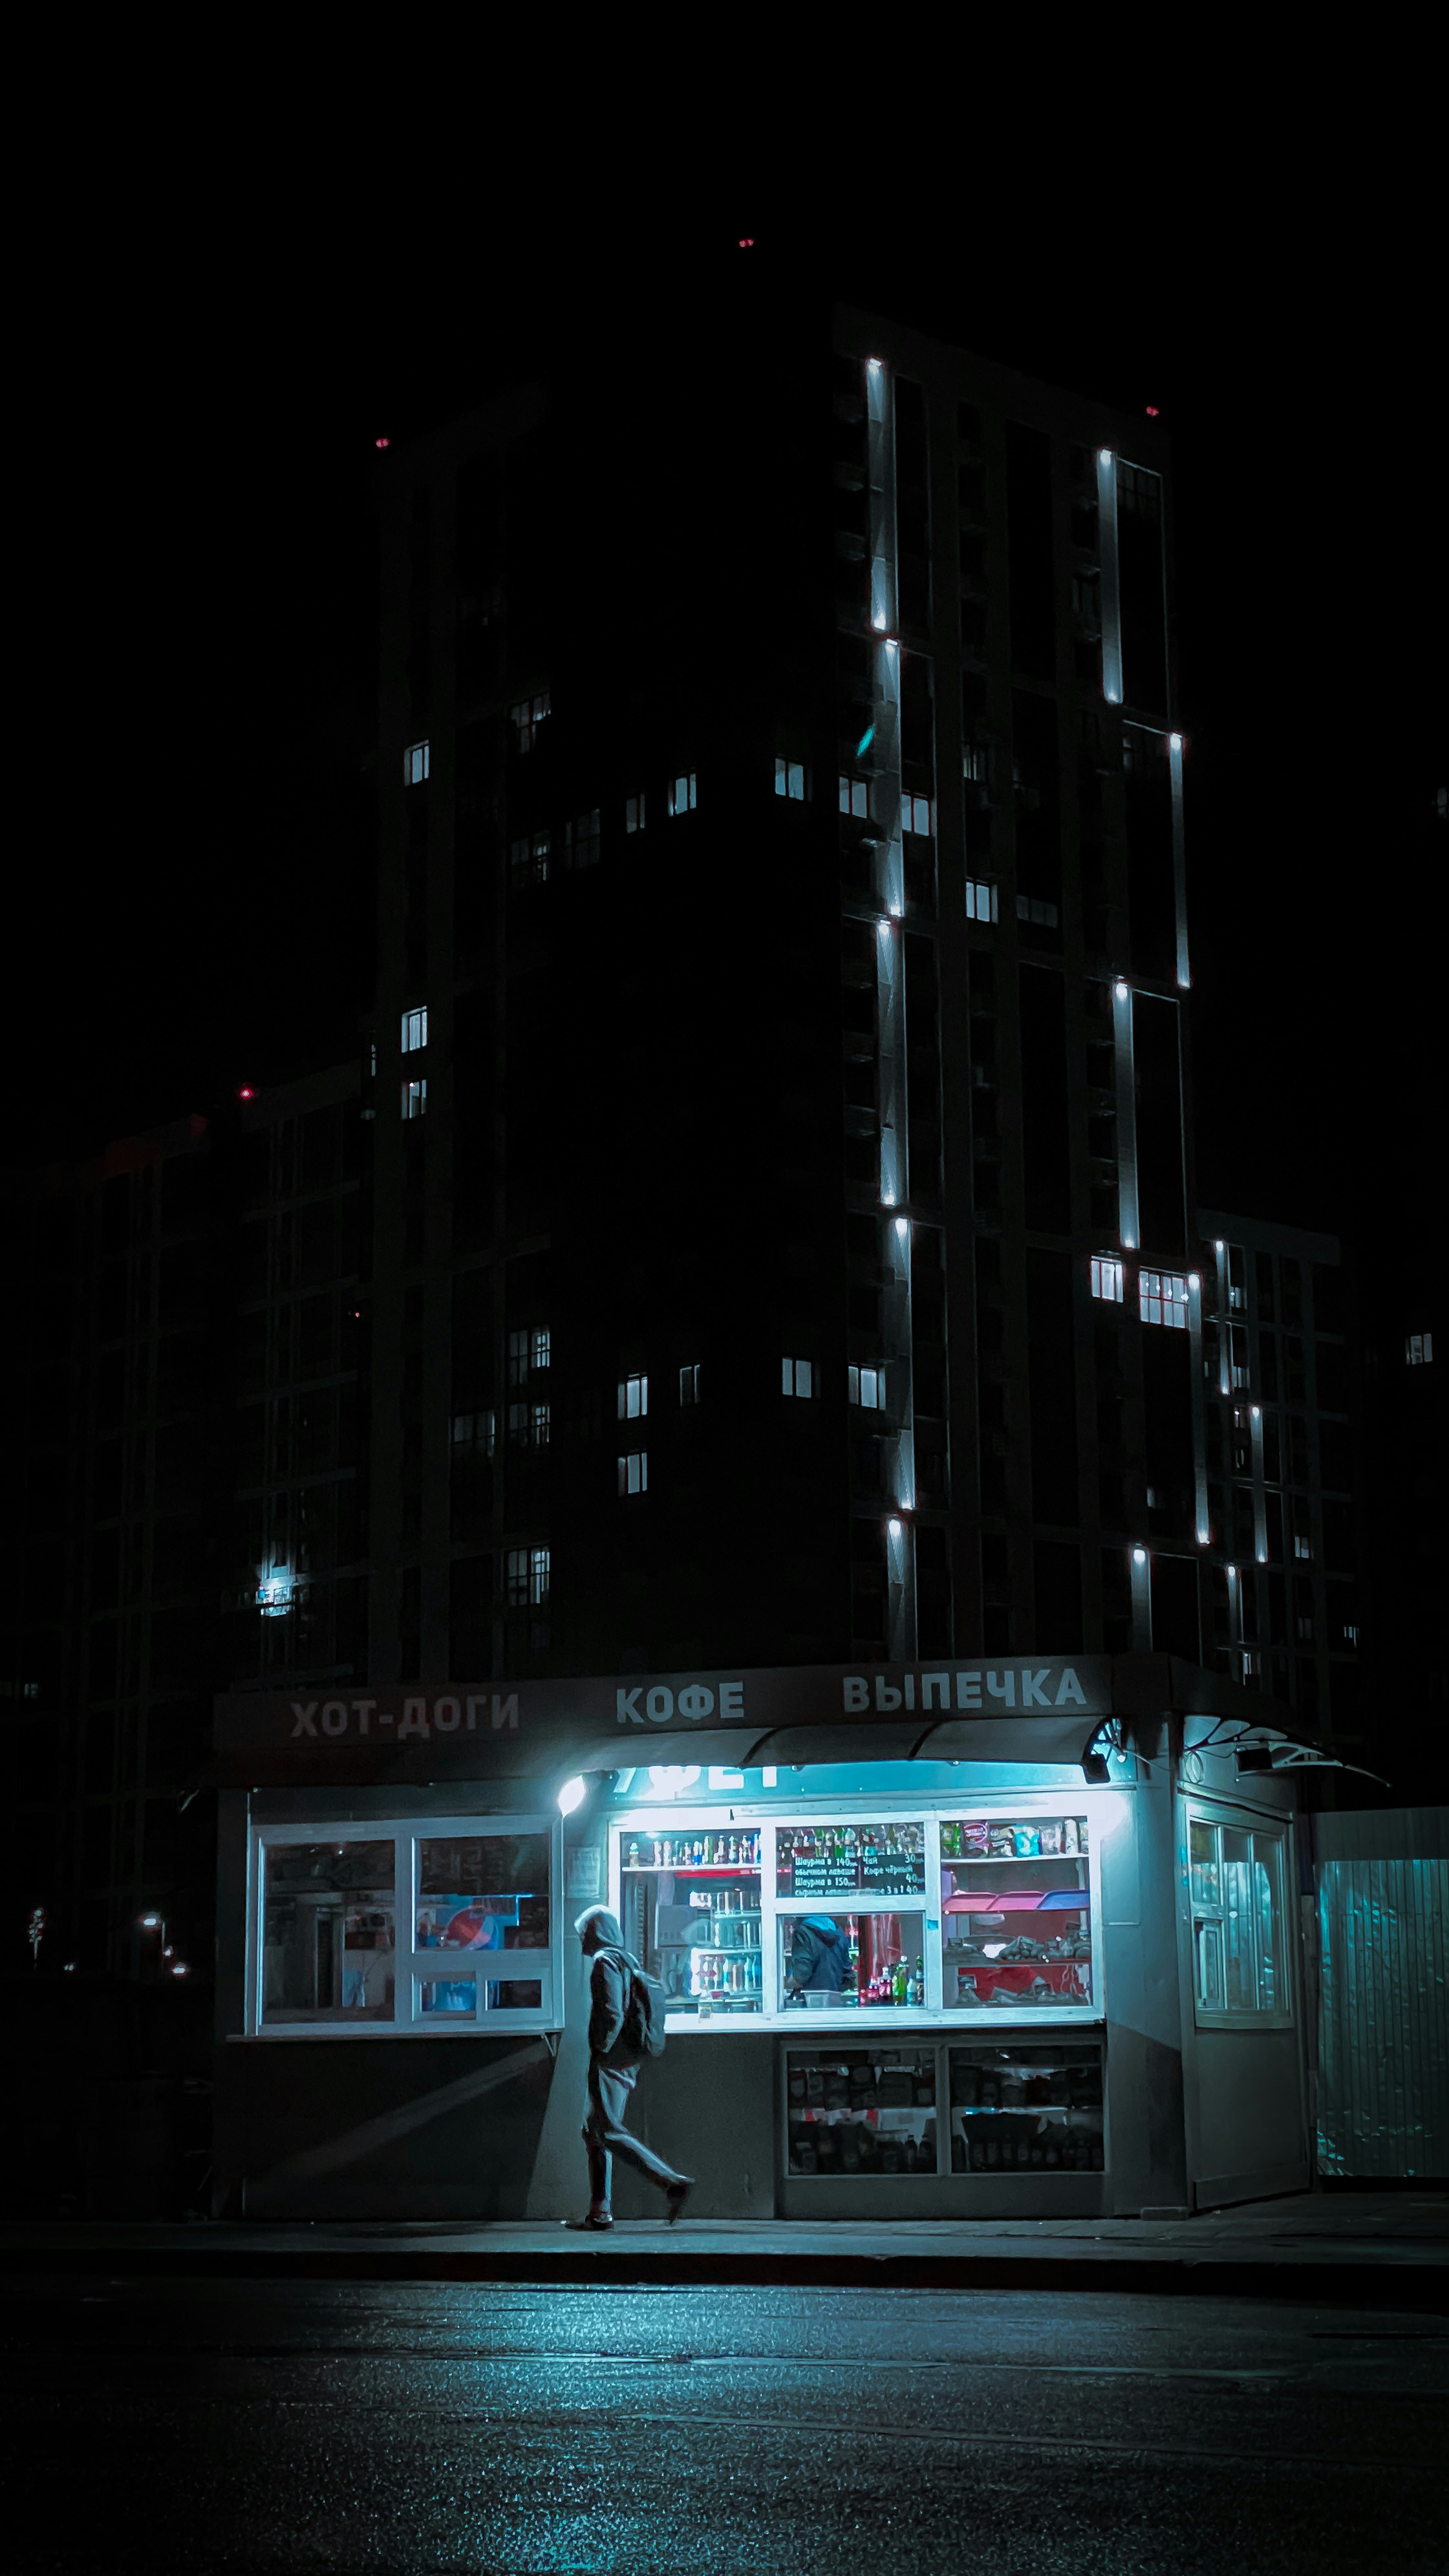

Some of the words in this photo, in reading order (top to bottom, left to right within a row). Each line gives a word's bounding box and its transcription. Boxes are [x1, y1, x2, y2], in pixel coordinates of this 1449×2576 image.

[843, 1668, 1087, 1712] ВЫПЕЧКА
[617, 1681, 744, 1723] КОФЕ
[290, 1694, 518, 1740] ХОТ-ДОГИ
[795, 1856, 825, 1867] Шаурма
[864, 1866, 884, 1876] Кофе
[795, 1877, 825, 1888] Шаурма
[886, 1885, 892, 1894] 3
[899, 1884, 904, 1894] 1
